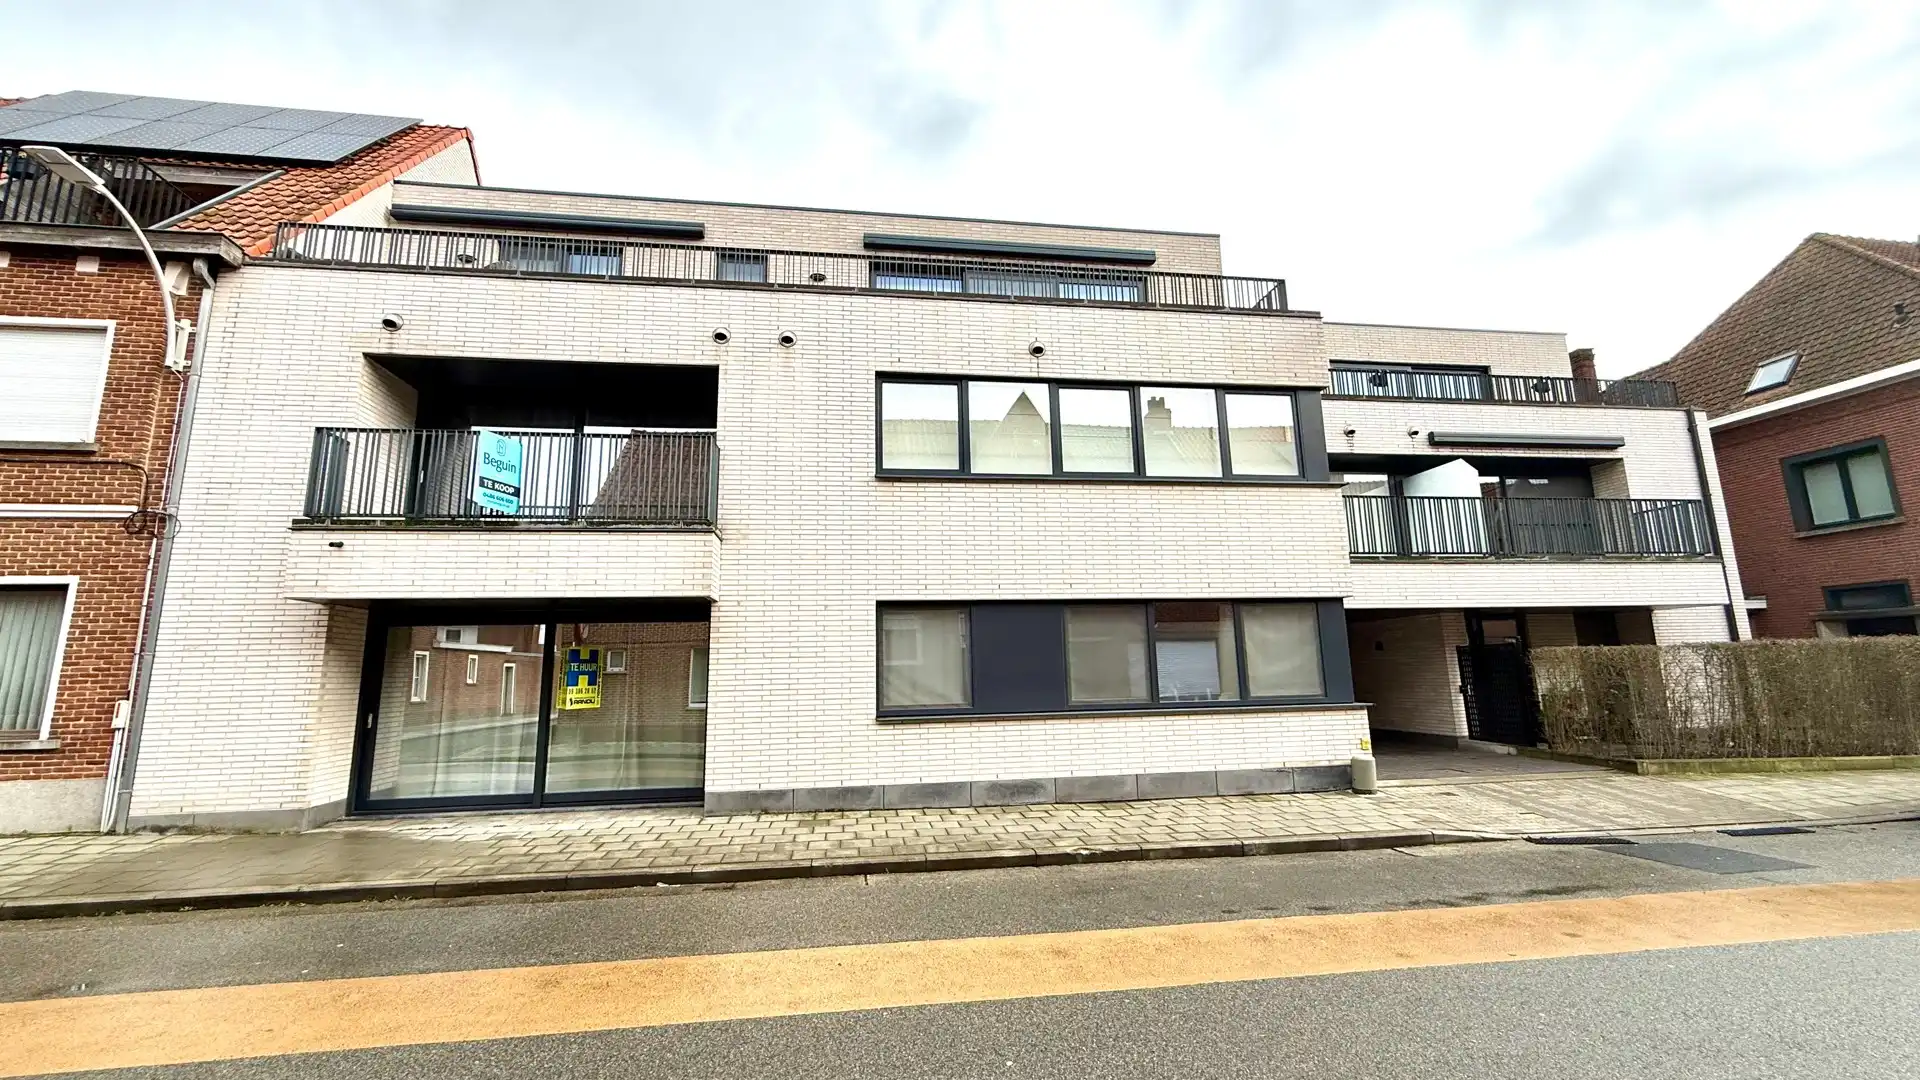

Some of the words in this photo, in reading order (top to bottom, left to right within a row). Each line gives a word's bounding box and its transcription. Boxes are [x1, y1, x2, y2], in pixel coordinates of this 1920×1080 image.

[483, 452, 516, 474] Beguin
[483, 479, 493, 488] TE
[494, 482, 515, 494] KOOP
[571, 663, 579, 671] TE
[580, 663, 598, 671] HUUR
